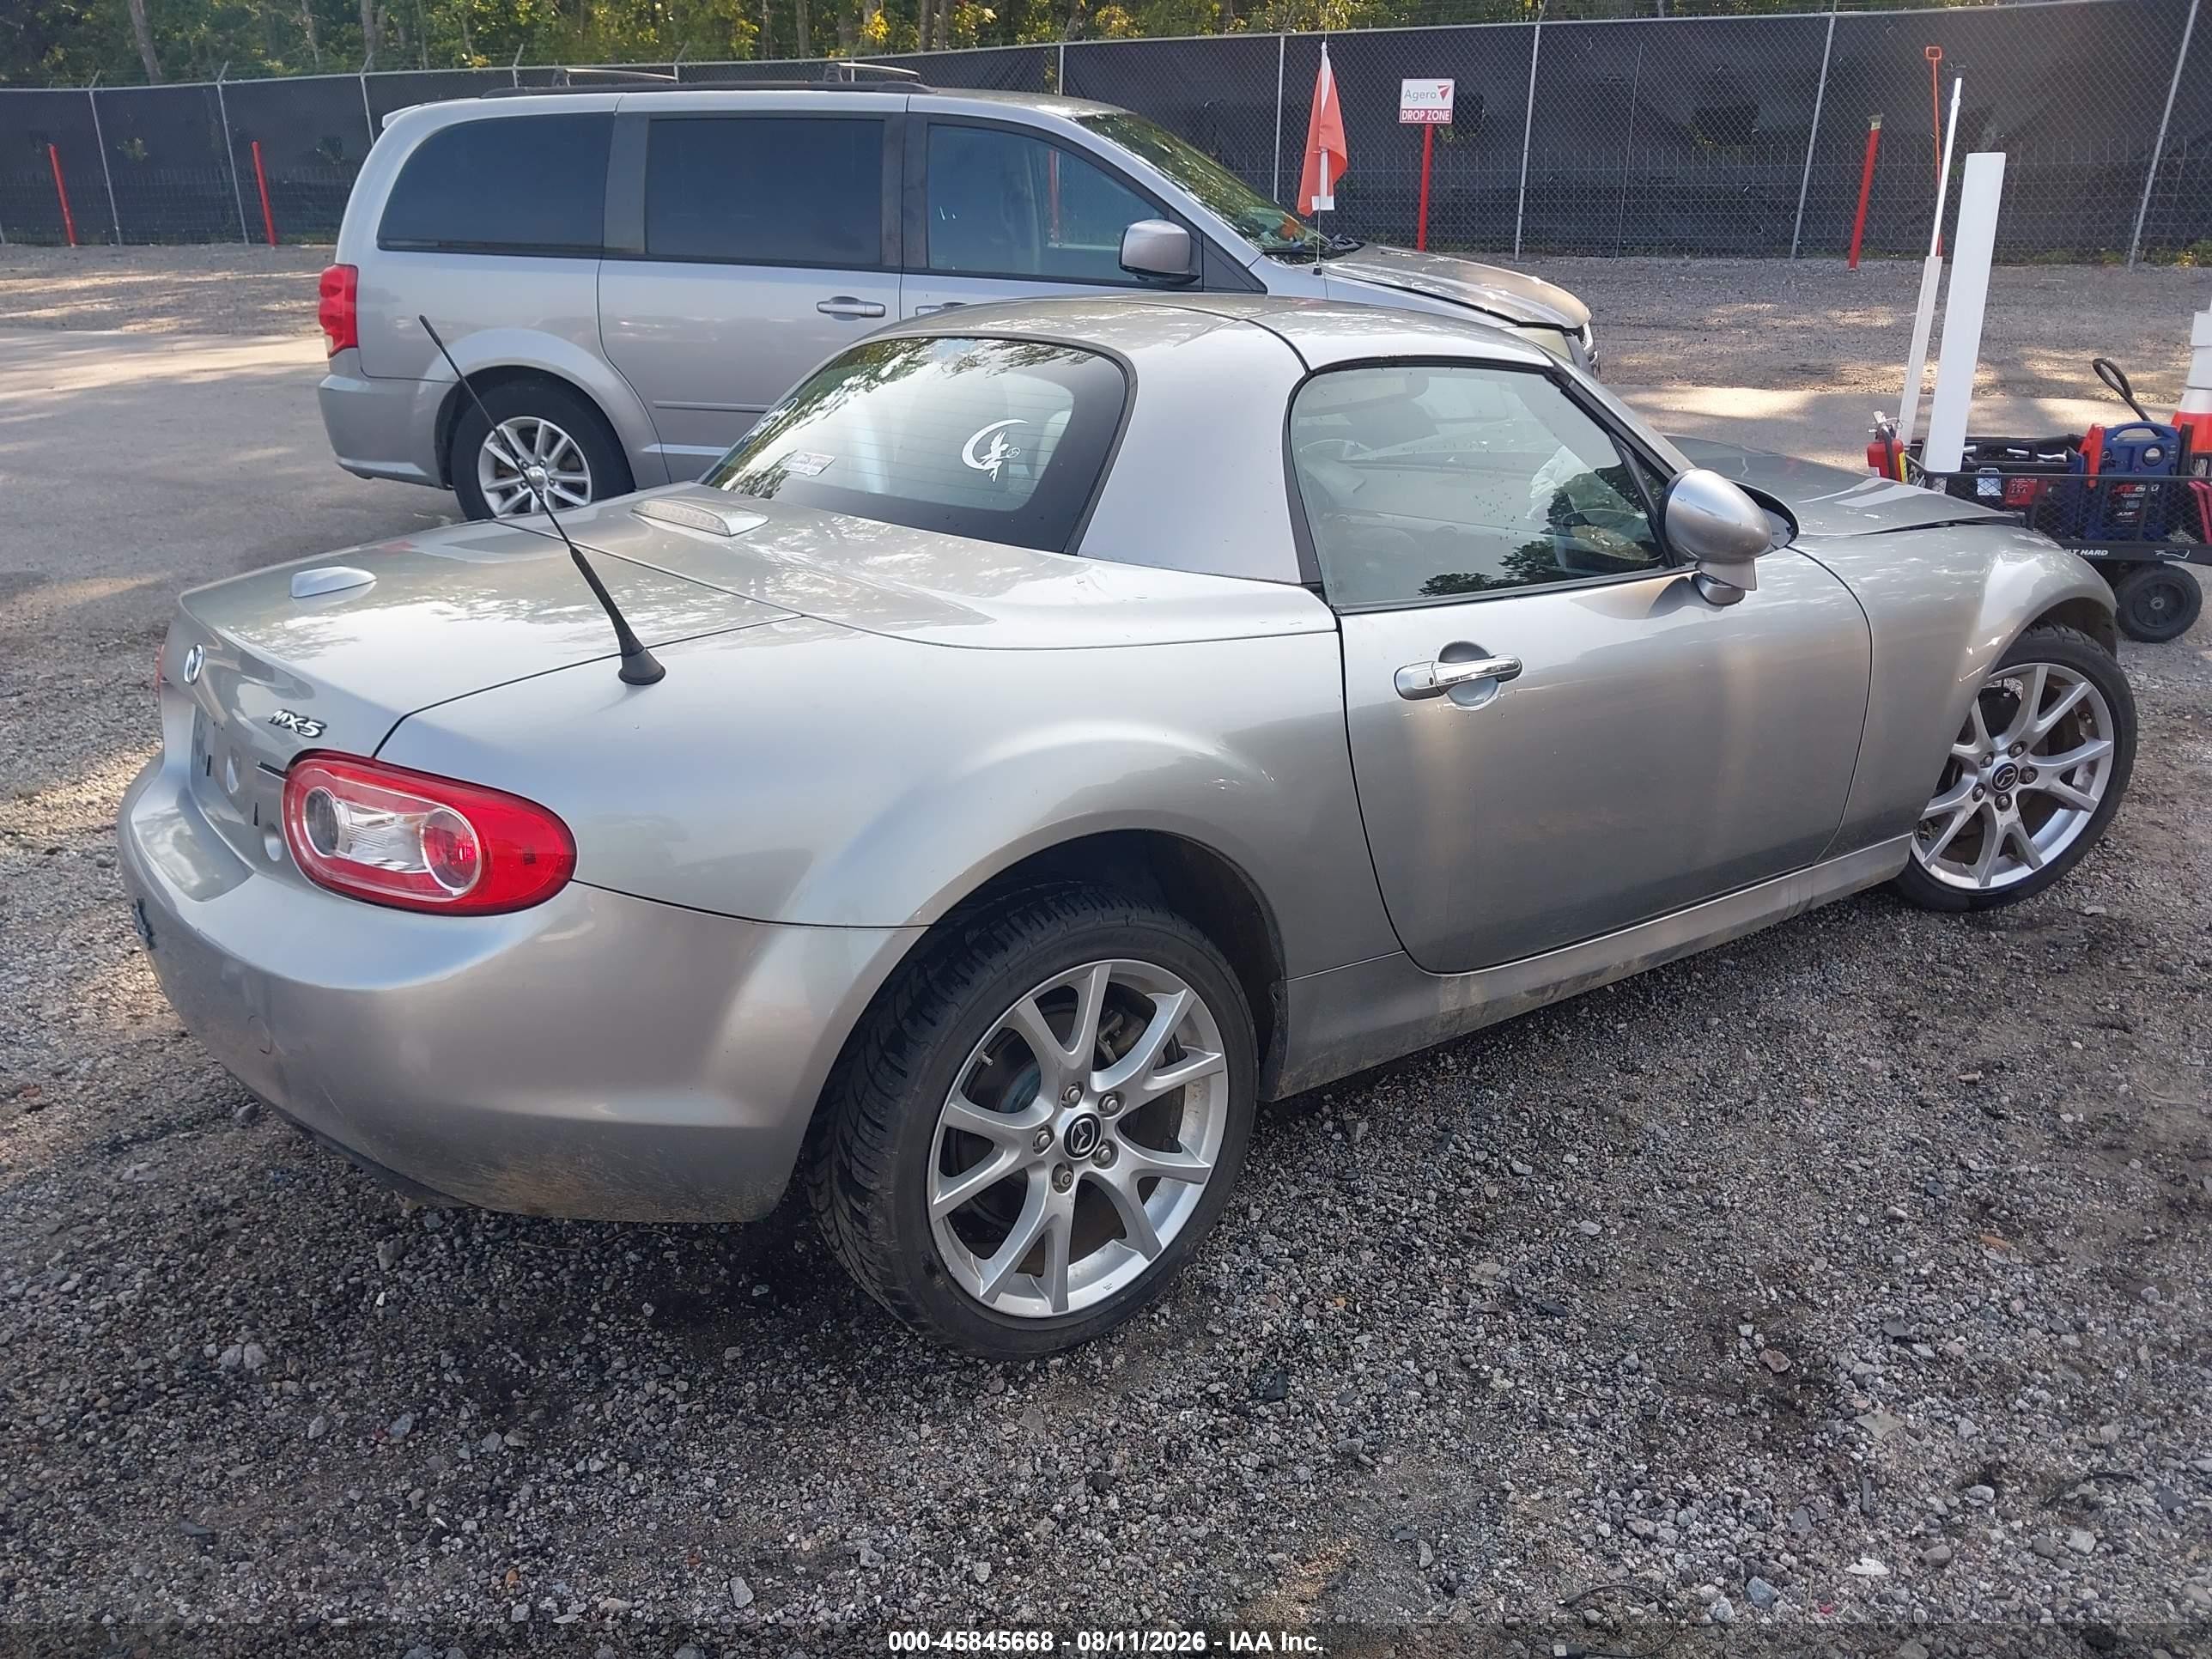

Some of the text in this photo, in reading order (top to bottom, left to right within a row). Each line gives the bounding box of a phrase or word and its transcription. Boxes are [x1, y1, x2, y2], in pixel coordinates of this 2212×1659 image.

[1404, 89, 1437, 102] Agero
[1401, 110, 1450, 121] DROP ZONE
[268, 710, 327, 738] MX-5
